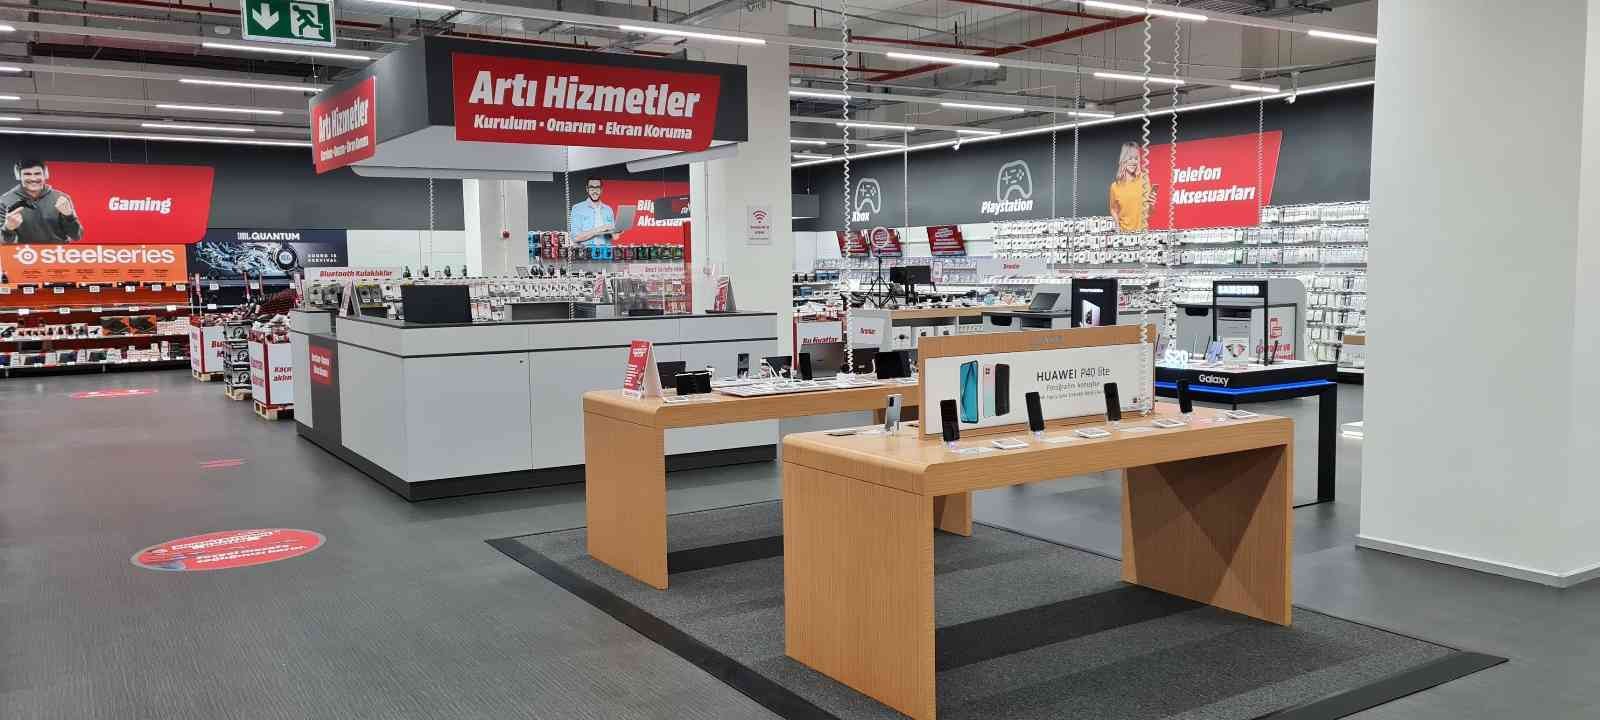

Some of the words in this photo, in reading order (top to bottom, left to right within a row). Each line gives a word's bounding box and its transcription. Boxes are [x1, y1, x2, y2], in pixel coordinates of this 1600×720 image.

[468, 70, 537, 107] Artı
[543, 75, 700, 118] Hizmetler
[331, 96, 369, 138] Hizmetler
[473, 113, 537, 131] Kurulum
[546, 117, 597, 134] Onarım
[605, 121, 643, 137] Ekran
[643, 122, 693, 140] Koruma
[1172, 165, 1222, 183] Telefon
[1172, 184, 1256, 205] Aksesuarları
[107, 196, 172, 214] Gaming
[981, 198, 1034, 216] Playstation
[851, 211, 870, 223] Xbox
[251, 232, 300, 241] QUANTUM
[41, 244, 176, 264] steelseries
[1036, 368, 1078, 382] HUAWEI
[1198, 374, 1230, 387] Galaxy
